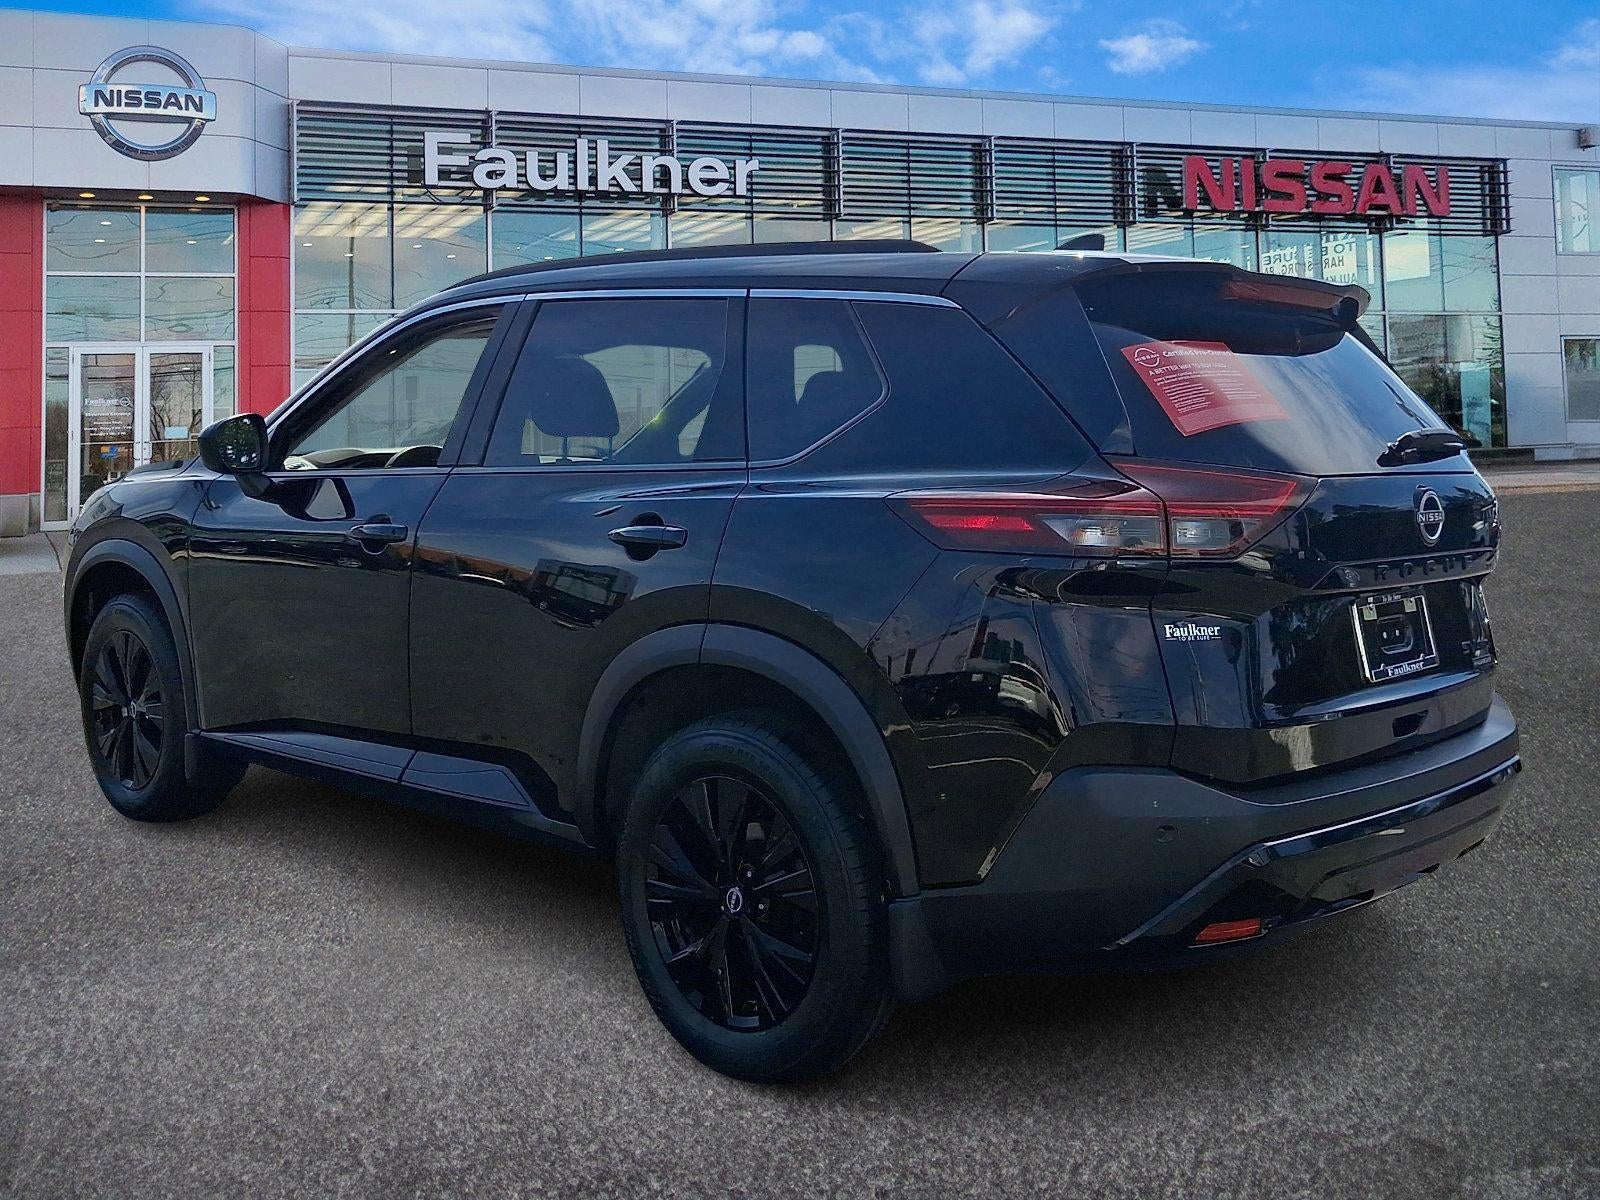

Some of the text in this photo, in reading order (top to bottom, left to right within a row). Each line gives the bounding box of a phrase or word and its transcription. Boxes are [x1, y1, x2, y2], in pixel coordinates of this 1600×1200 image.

[94, 89, 203, 113] NISSAN
[424, 131, 759, 196] Faulkner
[1183, 155, 1450, 216] NISSAN
[1135, 353, 1160, 363] NISSAN
[1163, 349, 1194, 358] Certified
[1155, 364, 1180, 375] BETTER
[1164, 623, 1220, 637] Faulkner
[1387, 661, 1425, 677] Faulkner
